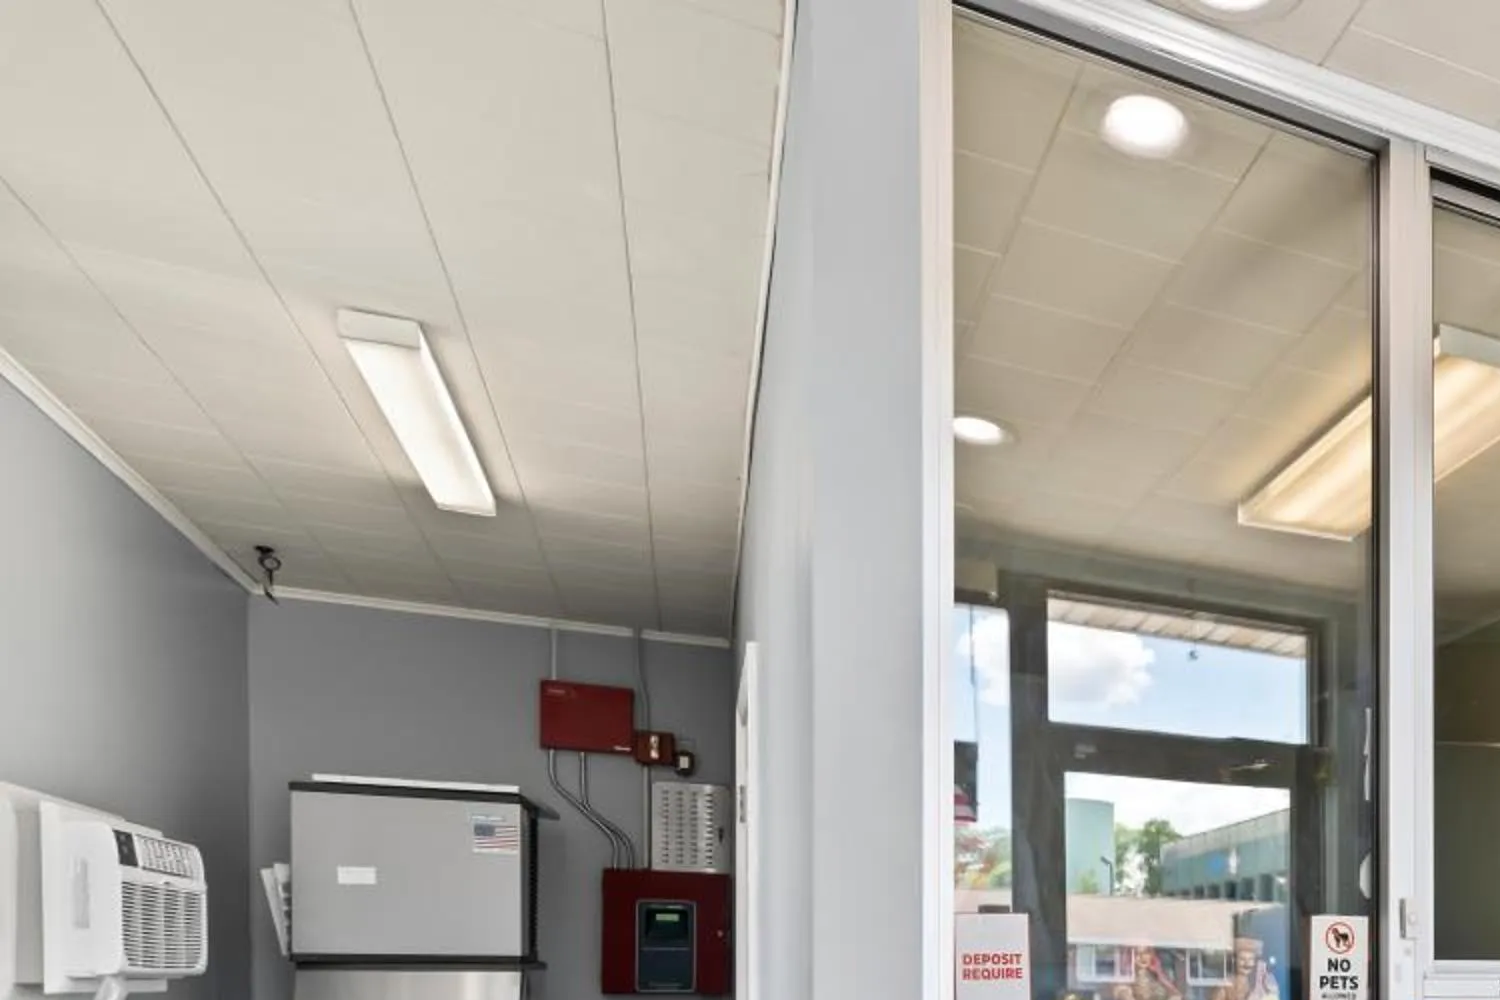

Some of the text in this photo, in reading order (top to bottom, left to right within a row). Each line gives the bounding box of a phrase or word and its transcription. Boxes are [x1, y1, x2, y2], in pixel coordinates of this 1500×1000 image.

[962, 953, 1022, 965] DEPOSIT
[1327, 958, 1351, 973] NO
[962, 967, 1024, 980] REQUIRE
[1319, 975, 1359, 990] PETS
